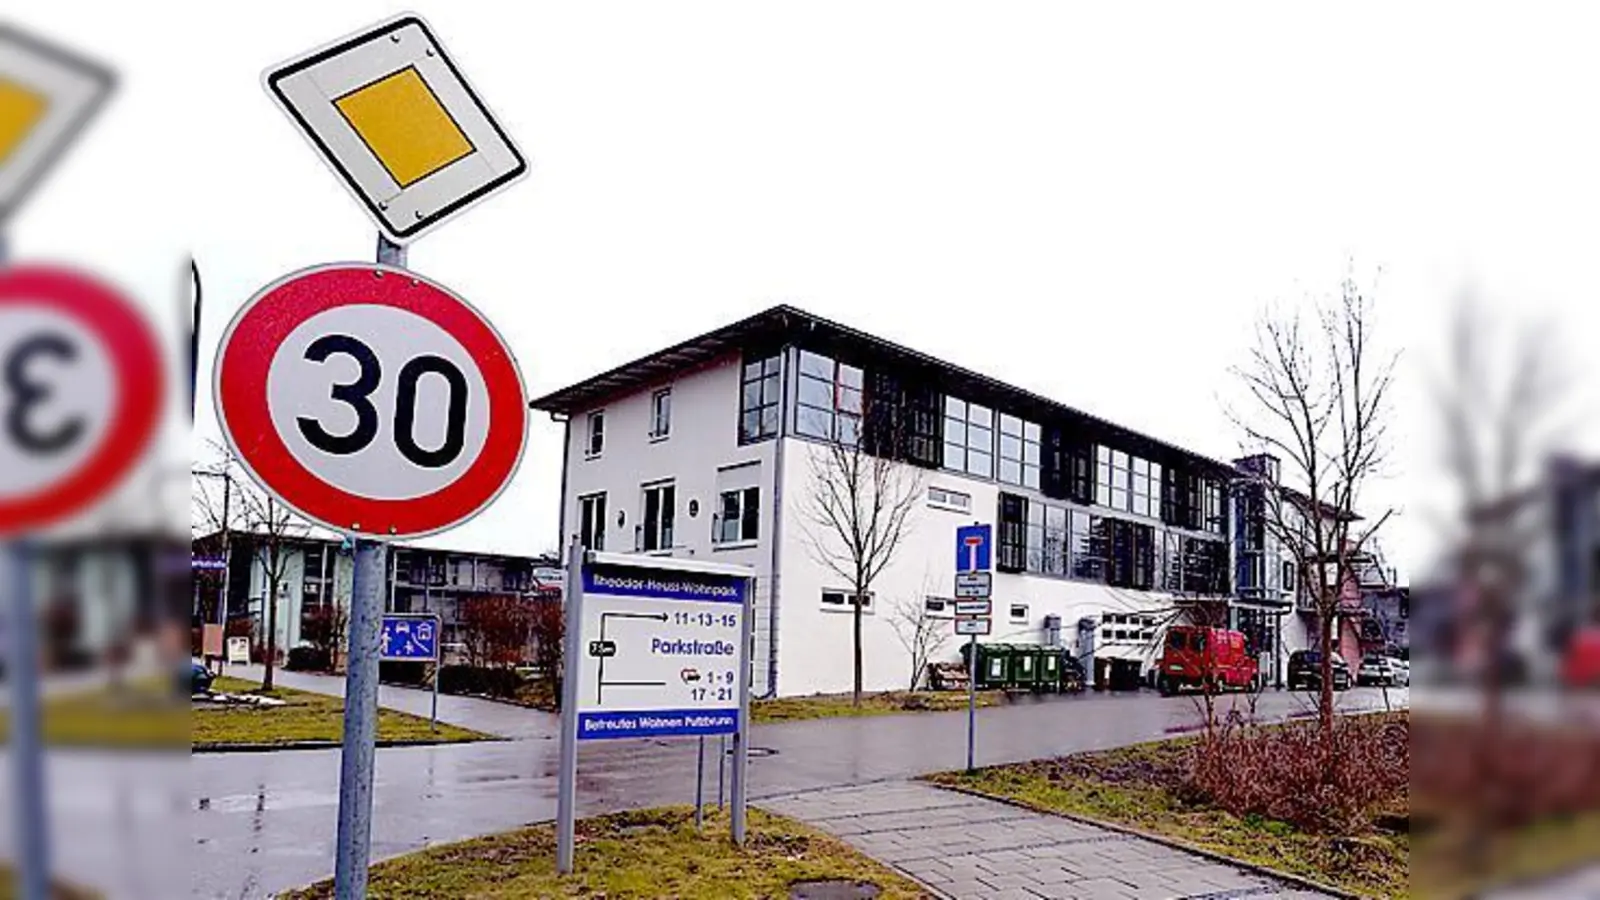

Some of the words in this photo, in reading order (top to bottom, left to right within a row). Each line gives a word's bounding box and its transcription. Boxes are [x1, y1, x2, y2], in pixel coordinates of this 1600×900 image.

[296, 334, 469, 468] 30
[651, 638, 734, 656] Parkstraße
[584, 718, 636, 731] Betreutes
[639, 716, 683, 729] Wohnen
